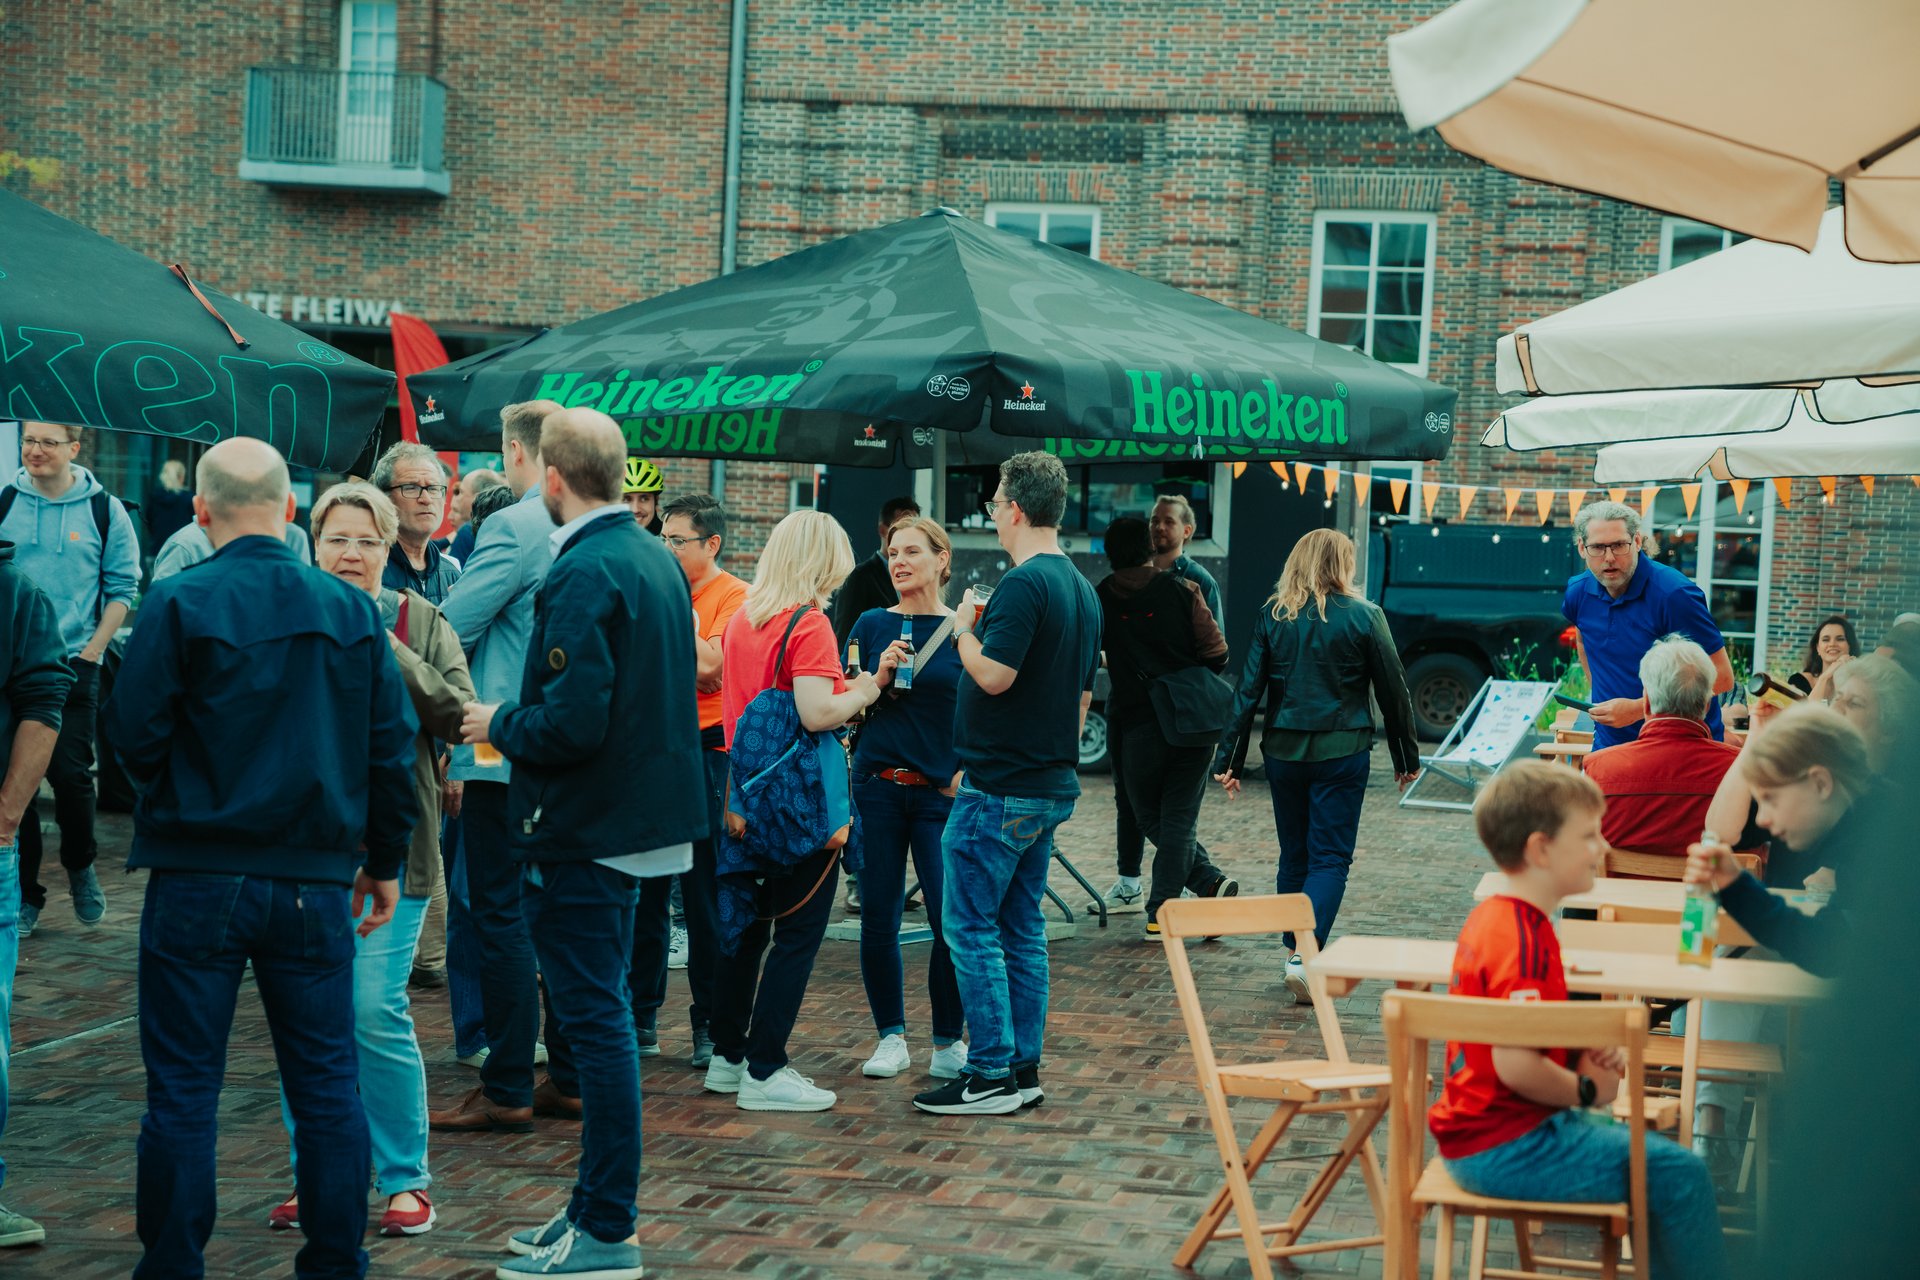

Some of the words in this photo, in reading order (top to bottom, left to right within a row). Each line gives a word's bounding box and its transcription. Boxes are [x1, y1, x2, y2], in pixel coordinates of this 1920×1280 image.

[535, 366, 804, 414] Heineken
[1003, 400, 1046, 411] Heineken
[1125, 369, 1348, 445] Heineken
